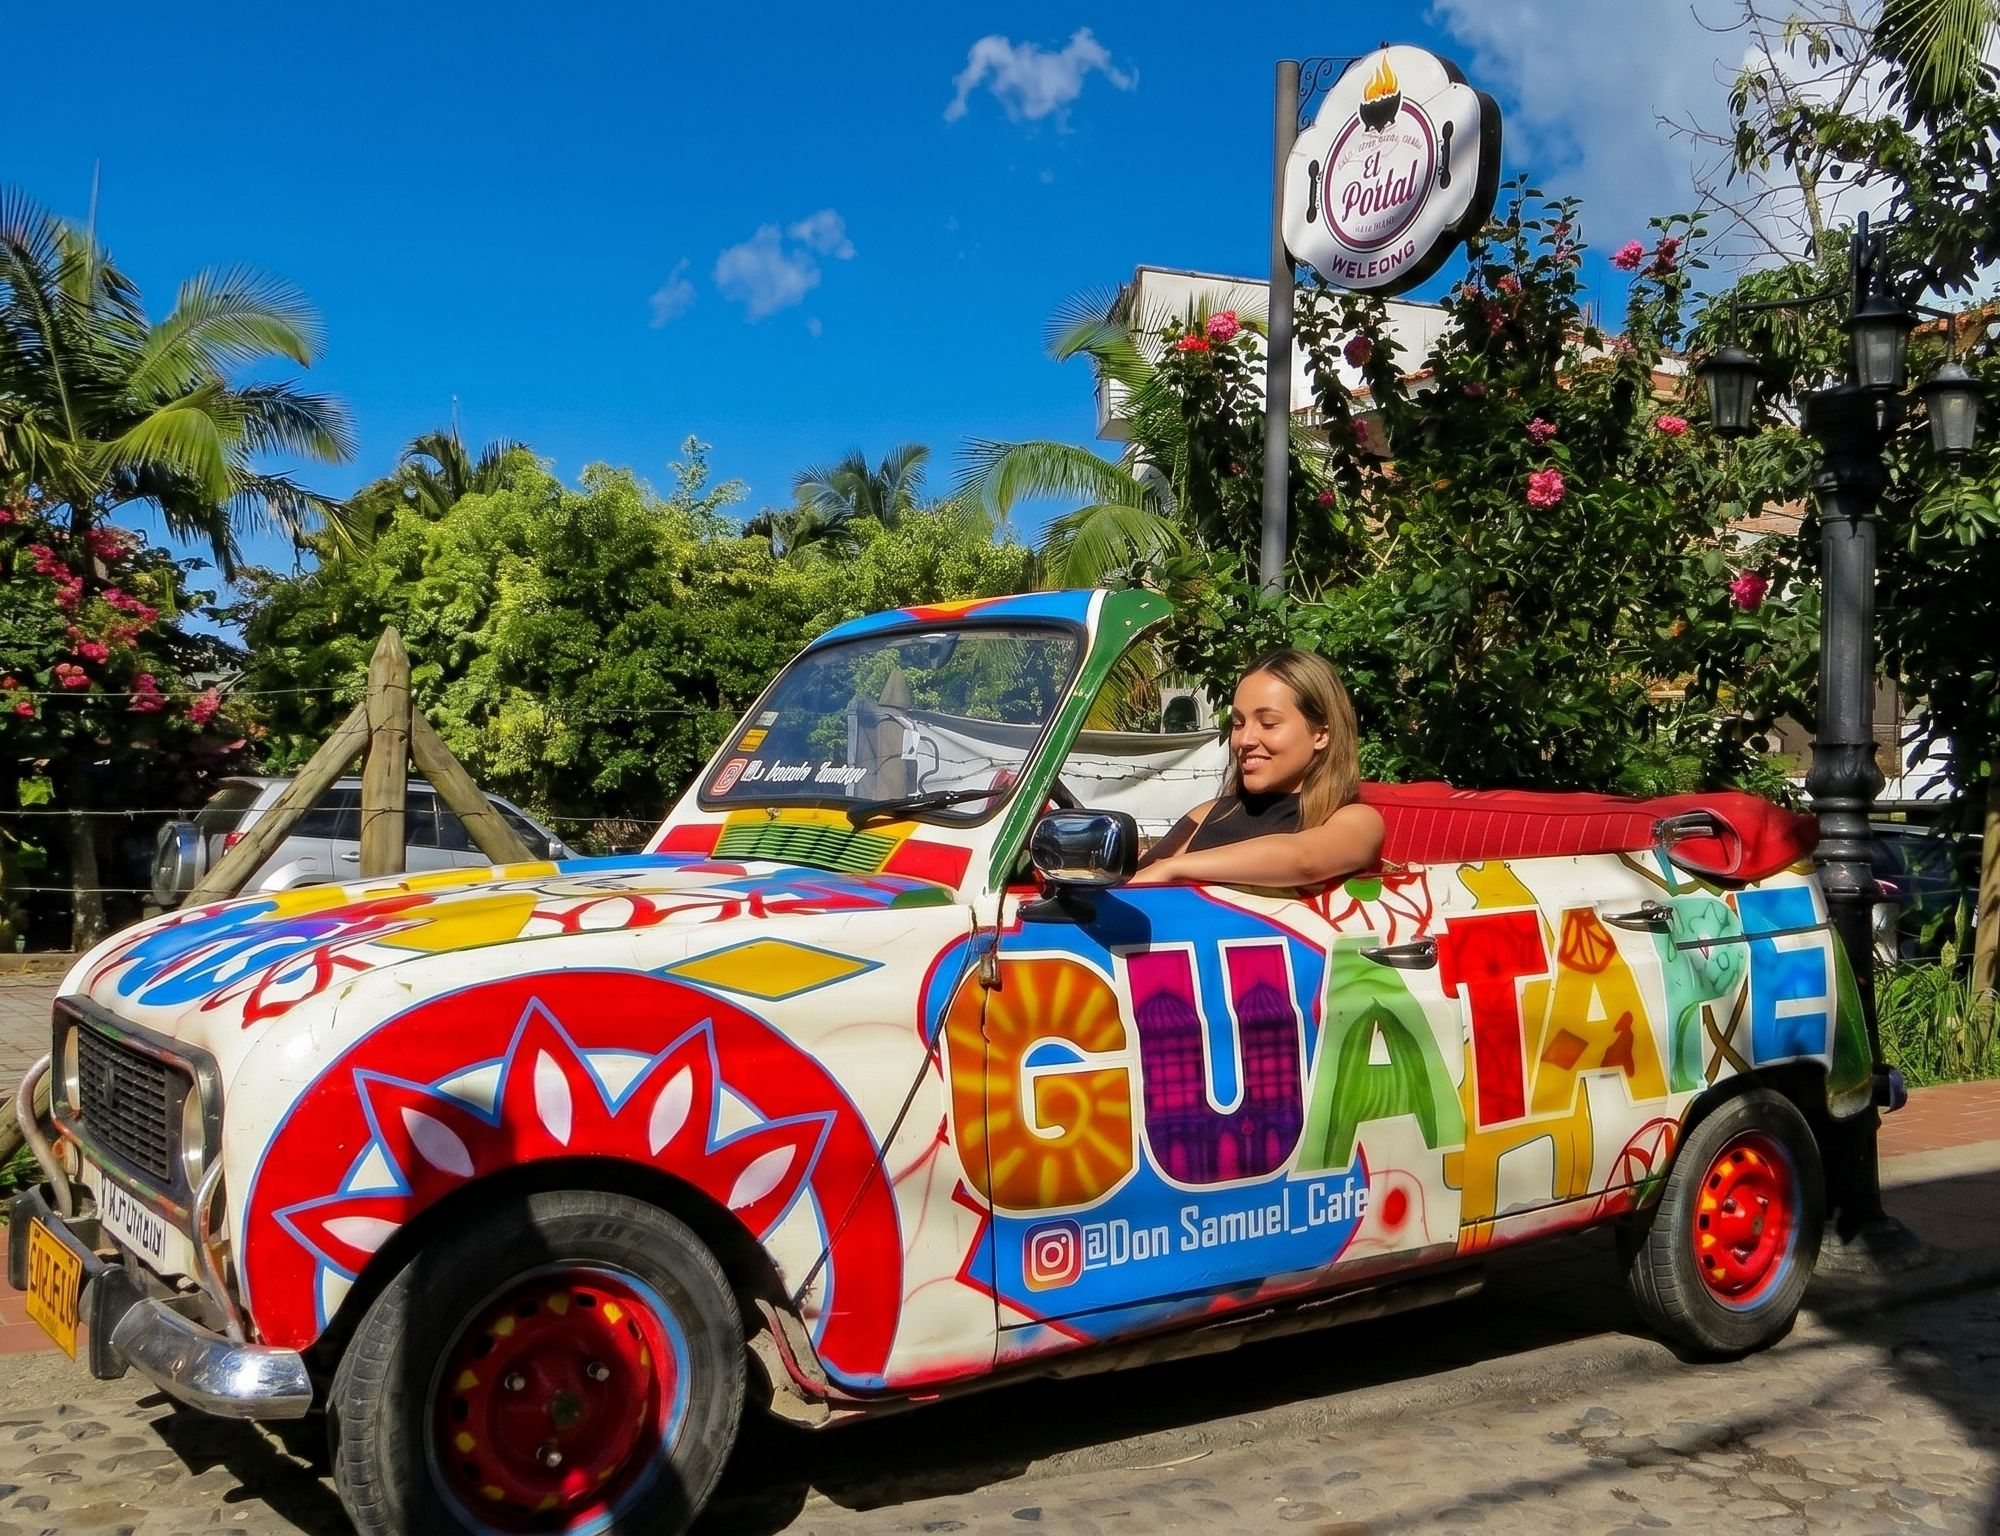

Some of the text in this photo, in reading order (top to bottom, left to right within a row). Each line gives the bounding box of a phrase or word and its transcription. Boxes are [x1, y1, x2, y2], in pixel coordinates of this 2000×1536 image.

[1342, 159, 1418, 222] Portal
[1363, 150, 1381, 179] El
[1332, 239, 1415, 279] WELEONG
[942, 884, 1834, 1216] GUATAPE
[1083, 1177, 1370, 1271] @Don Samuel_Cafe
